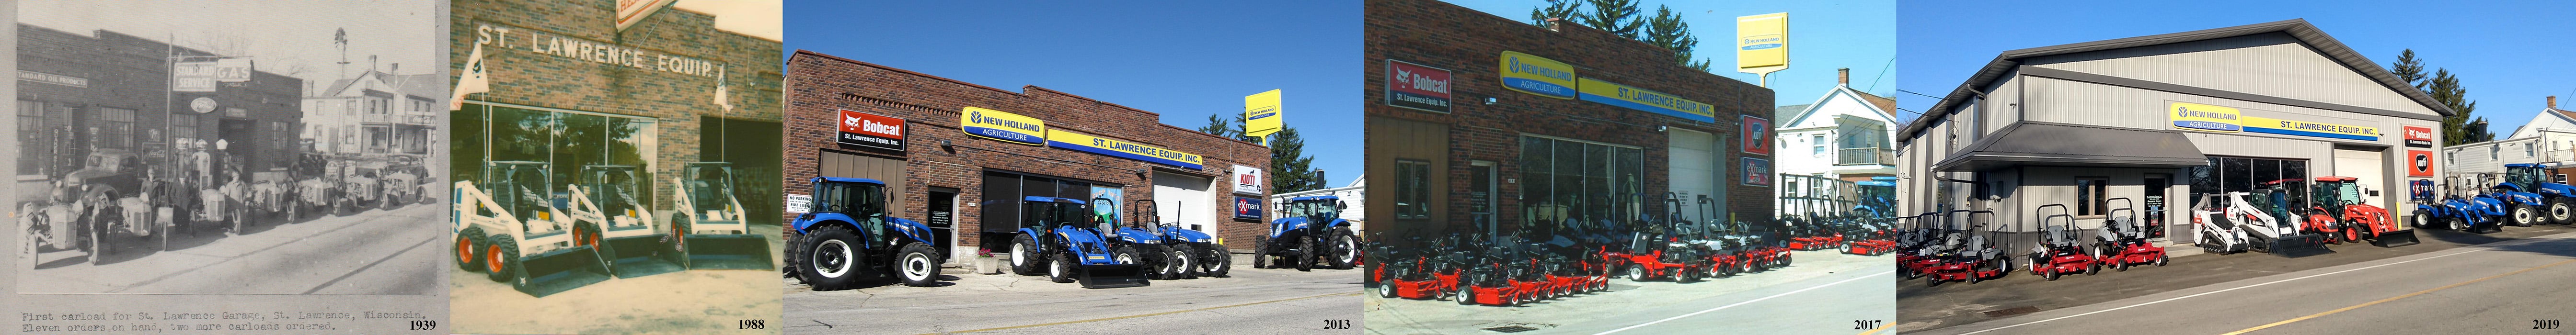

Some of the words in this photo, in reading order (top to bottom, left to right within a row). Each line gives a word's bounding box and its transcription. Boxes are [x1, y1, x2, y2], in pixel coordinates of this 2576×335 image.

[479, 25, 513, 49] ST.
[532, 33, 644, 68] LAWRENCE
[657, 53, 712, 78] EQUIP.
[176, 66, 215, 76] STANDARD
[217, 67, 250, 78] GAS
[1521, 63, 1538, 75] NEW
[1540, 67, 1572, 82] HOLLAND
[17, 72, 46, 81] TANDARD
[59, 77, 86, 86] PRODUCTS
[179, 77, 211, 88] SERVICE
[1414, 73, 1447, 94] Bobcat
[1521, 80, 1561, 94] AGRICULTURE
[1404, 94, 1425, 104] Lawrence
[1426, 97, 1438, 106] Equip.
[1618, 87, 1630, 99] ST.
[1633, 90, 1674, 108] LAWRENCE
[1676, 99, 1698, 112] EQUIP.
[1699, 104, 1712, 115] INC.
[2207, 112, 2237, 120] HOLLAND
[863, 119, 900, 136] Bobcat
[984, 116, 1002, 126] NEW
[1004, 120, 1040, 132] HOLLAND
[2189, 121, 2227, 129] AGRICULTURE
[2295, 122, 2336, 132] LAWRENCE
[2339, 126, 2360, 134] EQUIP.
[852, 134, 875, 142] Lawrence
[982, 128, 1027, 141] AGRICULTURE
[2415, 130, 2431, 139] Bobcat
[1093, 138, 1106, 147] ST.
[1109, 141, 1156, 156] LAWRENCE
[1159, 150, 1184, 160] EQUIP.
[1185, 154, 1200, 163] INC.
[1240, 173, 1255, 185] KIOTI
[22, 312, 54, 321] First
[61, 312, 106, 321] carload
[113, 312, 132, 320] for
[138, 312, 153, 320] St.
[163, 312, 215, 320] Lawrence
[222, 311, 264, 321] Garage,
[273, 311, 290, 320] St.
[299, 311, 355, 321] Lawrence,
[364, 311, 426, 319] Wisconsin.
[23, 324, 60, 332] Eleven
[67, 324, 105, 332] orders
[131, 323, 162, 333] hand,
[229, 323, 279, 331] carloads
